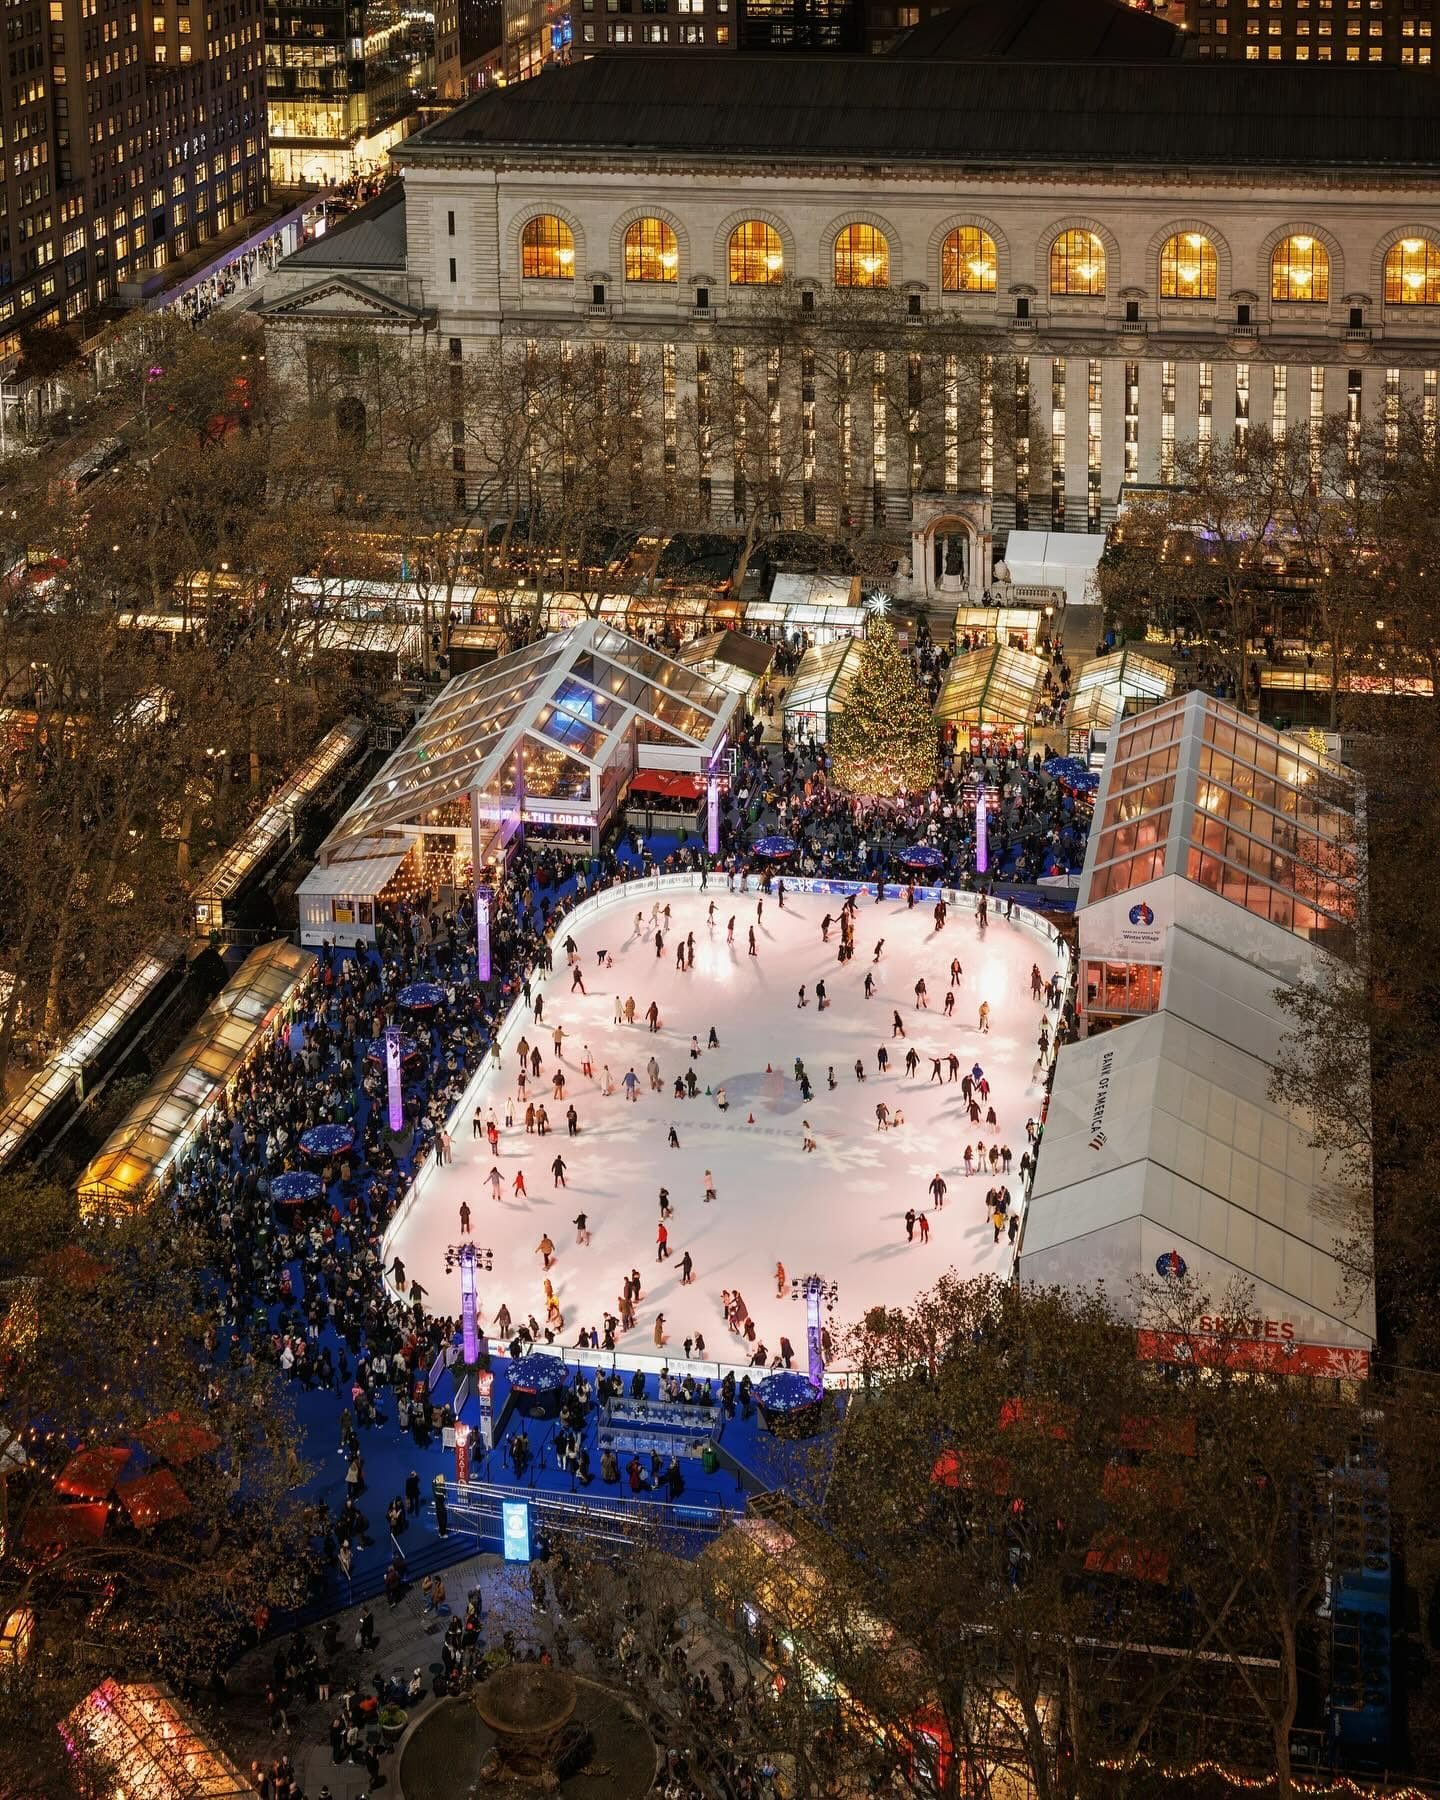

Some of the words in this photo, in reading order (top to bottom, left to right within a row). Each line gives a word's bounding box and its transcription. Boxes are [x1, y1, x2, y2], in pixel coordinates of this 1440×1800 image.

[1101, 1051, 1114, 1076] BANK
[1098, 1077, 1110, 1089] OF
[1091, 1091, 1108, 1134] AMERICA
[1199, 1315, 1295, 1340] SKATES
